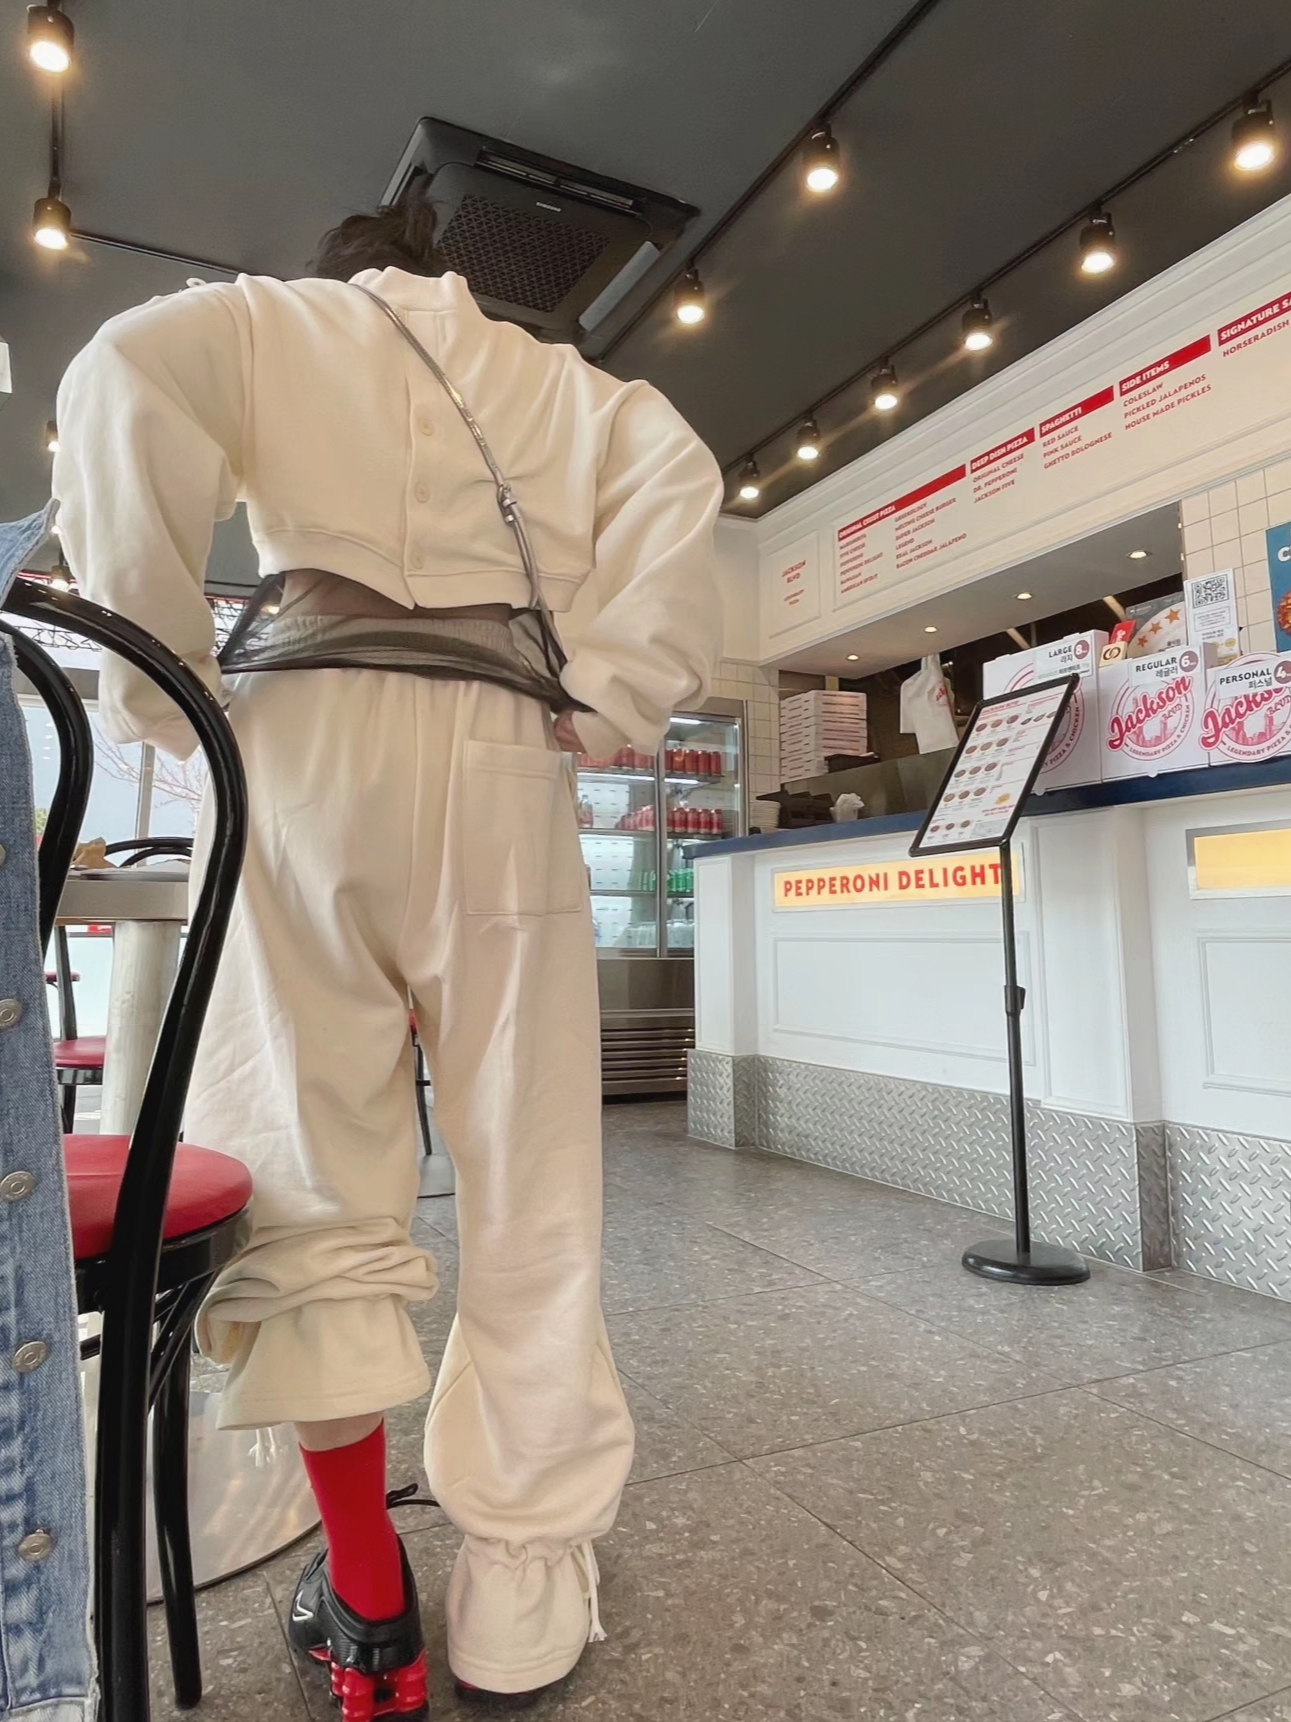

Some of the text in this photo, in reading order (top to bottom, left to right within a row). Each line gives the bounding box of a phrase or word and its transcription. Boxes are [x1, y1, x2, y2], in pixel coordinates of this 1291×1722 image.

[1220, 298, 1291, 340] SIGNATURE S
[1223, 320, 1290, 357] HORSERADISH
[1121, 361, 1170, 392] SIDE ITEMS
[1123, 382, 1164, 407] COLESLAW
[1124, 374, 1206, 419] PICKLED JALAPENOS
[1125, 384, 1212, 430] HOUSE MADE PICKLES
[1041, 406, 1082, 433] SPAGHETTI
[1043, 425, 1079, 448] RED SAUCE
[1043, 435, 1082, 459] PINK SAUCE
[1044, 432, 1112, 469] GHETTO BOLOGNESE
[971, 436, 1029, 470] DEEP DISH PIZZA
[973, 453, 1024, 483] ORIGINAL CHEESE
[973, 479, 1015, 504] JACKSON FIVE
[984, 467, 1018, 488] PEPPERONI
[1049, 644, 1083, 658] LARGE 8
[1060, 654, 1073, 663] 라지
[1135, 655, 1190, 672] REGULAR 6
[1219, 666, 1287, 685] PERSONAL 4
[1248, 677, 1273, 689] 퍼스널
[1108, 676, 1191, 750] Jackson
[1201, 687, 1284, 748] Jacks
[1049, 749, 1067, 765] PIZZA
[1069, 706, 1080, 741] CHICKEN
[1129, 746, 1162, 758] LEGENDARY
[1161, 739, 1178, 753] PIZZA
[1180, 704, 1190, 733] CHICKEN
[1227, 745, 1266, 757] LEGENDARY
[1266, 735, 1286, 752] PIZZA
[784, 863, 1002, 897] PEPPERONI DELIGHT
